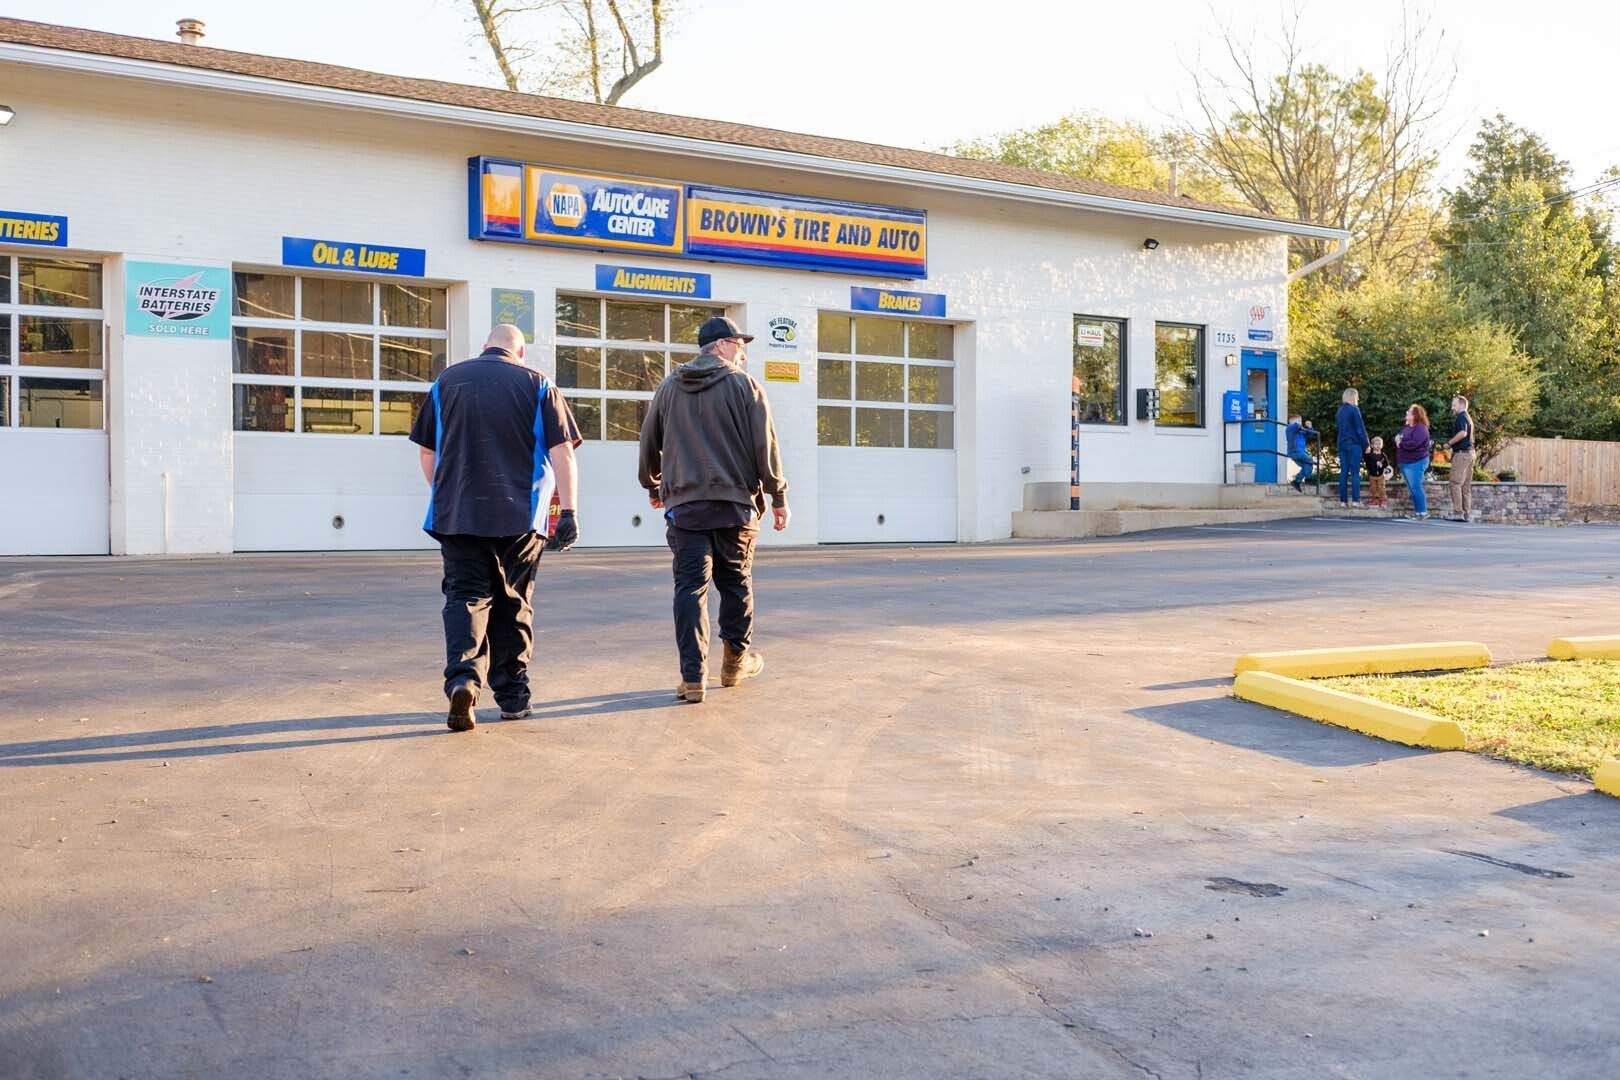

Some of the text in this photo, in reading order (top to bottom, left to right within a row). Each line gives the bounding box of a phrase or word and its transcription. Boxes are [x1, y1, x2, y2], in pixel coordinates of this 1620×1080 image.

[553, 194, 580, 217] NAPA
[607, 214, 656, 237] CENTER
[699, 207, 920, 252] BROWN'S TIRE AND AUTO
[341, 248, 355, 267] &
[358, 246, 399, 270] LUBE
[612, 268, 696, 294] ALIGNMENTS
[139, 286, 216, 301] INTERSTATE
[878, 291, 922, 312] BRAKES
[141, 299, 211, 312] BATTERIES
[149, 324, 209, 335] SOLD HERE
[768, 318, 777, 328] WE
[1216, 332, 1236, 344] 7735
